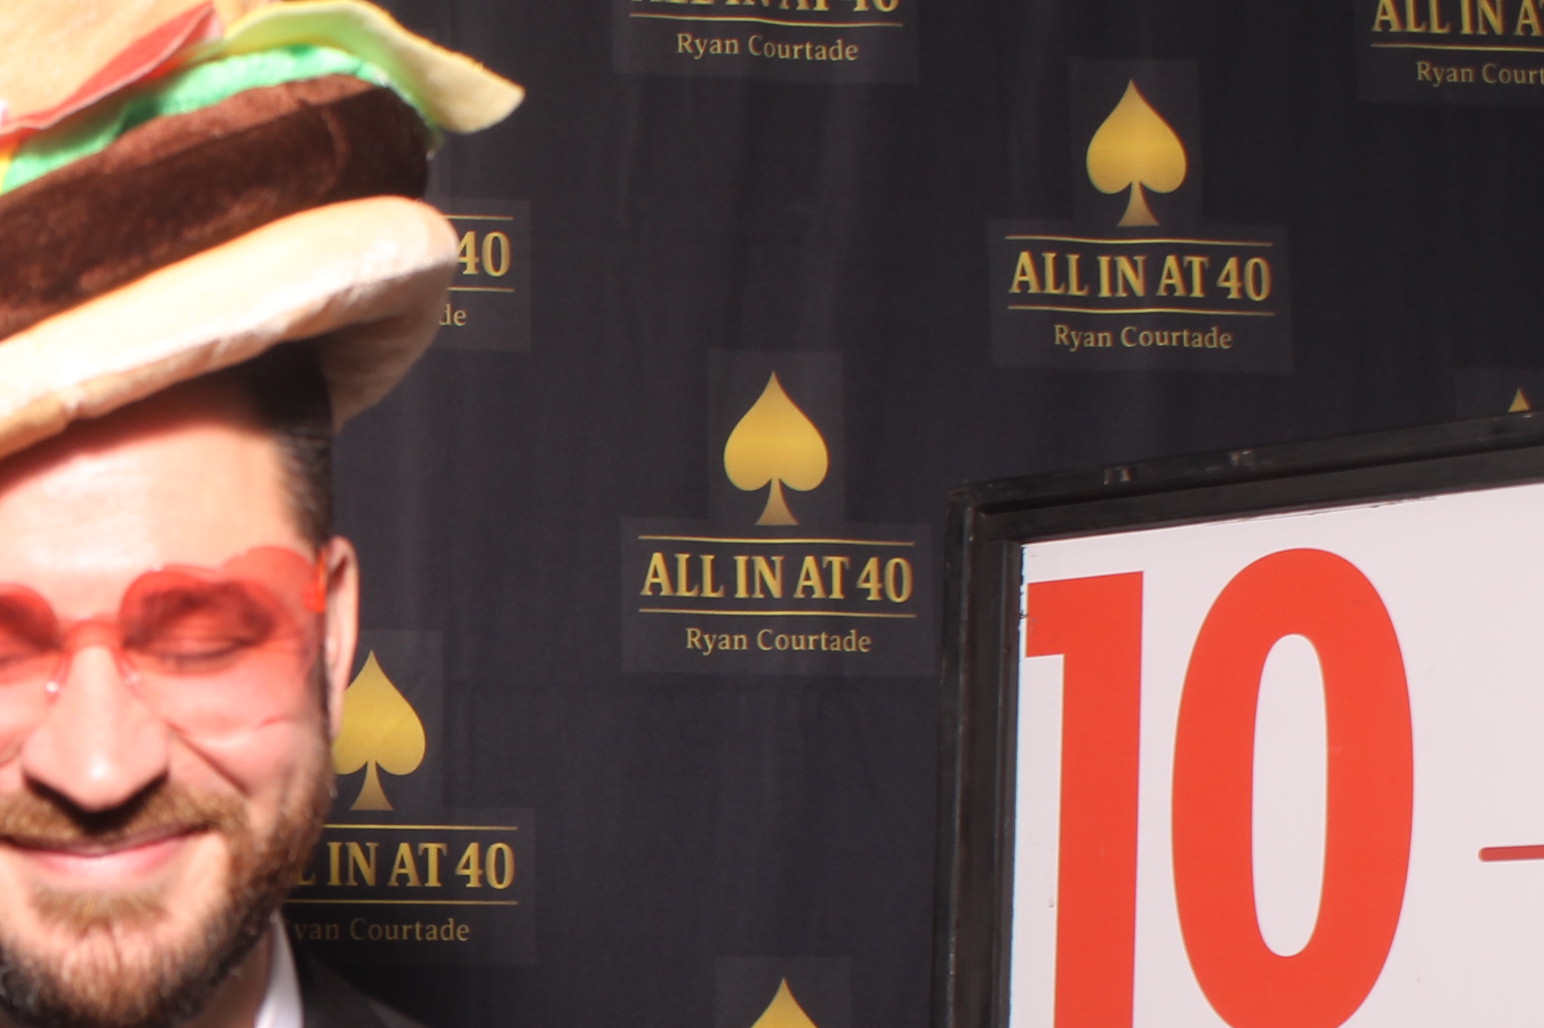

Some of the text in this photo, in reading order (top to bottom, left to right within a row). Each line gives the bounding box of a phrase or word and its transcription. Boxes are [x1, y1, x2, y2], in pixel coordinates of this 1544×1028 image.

[1372, 0, 1544, 36] ALL IN A
[677, 32, 860, 62] Ryan Courtade
[1416, 61, 1544, 88] Ryan Court
[457, 230, 512, 277] 40
[1008, 250, 1271, 302] ALL IN AT 40
[1053, 324, 1233, 352] Ryan Courtade
[640, 552, 912, 603] ALL IN AT 40
[686, 627, 872, 656] Ryan Courtade
[327, 842, 515, 890] IN AT 40
[349, 917, 471, 942] Courtade
